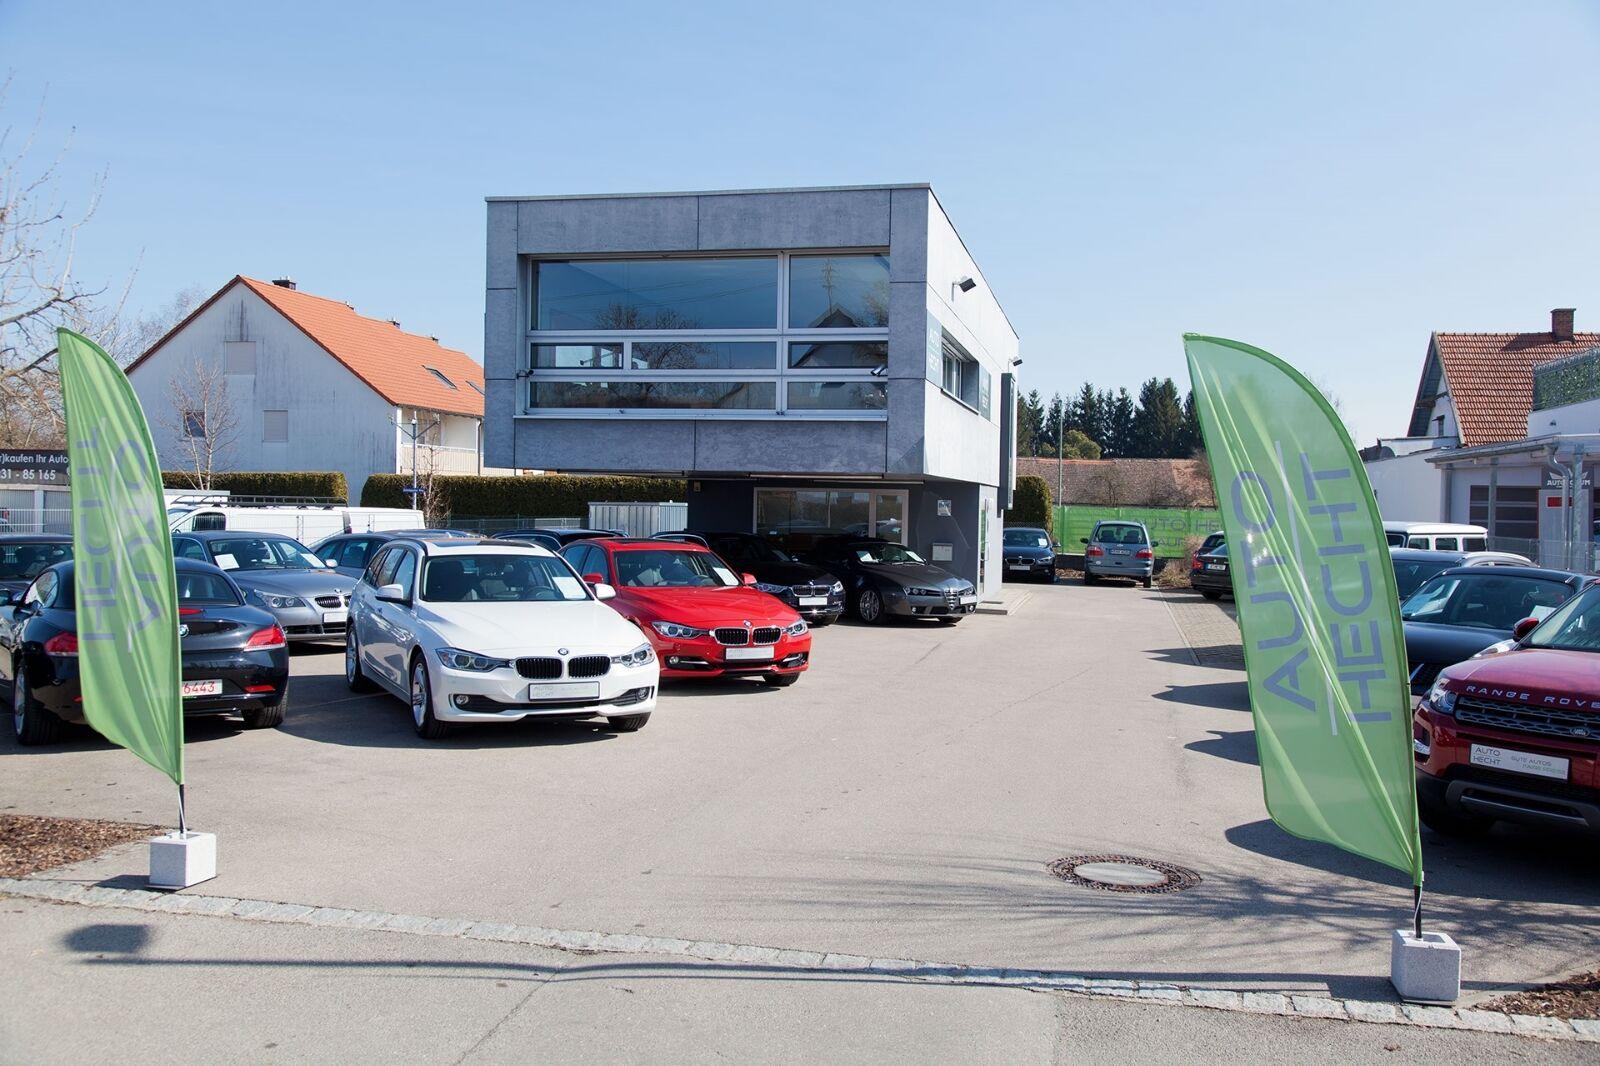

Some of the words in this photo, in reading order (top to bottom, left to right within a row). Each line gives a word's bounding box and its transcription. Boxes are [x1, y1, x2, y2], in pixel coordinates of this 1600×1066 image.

[36, 453, 47, 463] Ihr
[48, 455, 69, 463] Auto
[22, 469, 35, 480] 85
[38, 470, 56, 480] 165
[1231, 470, 1316, 714] AUTO
[1301, 452, 1392, 724] HECHT
[183, 681, 215, 694] 6443
[1466, 685, 1531, 700] RANGE
[1475, 747, 1501, 757] AUTO
[1473, 756, 1502, 765] HECHT
